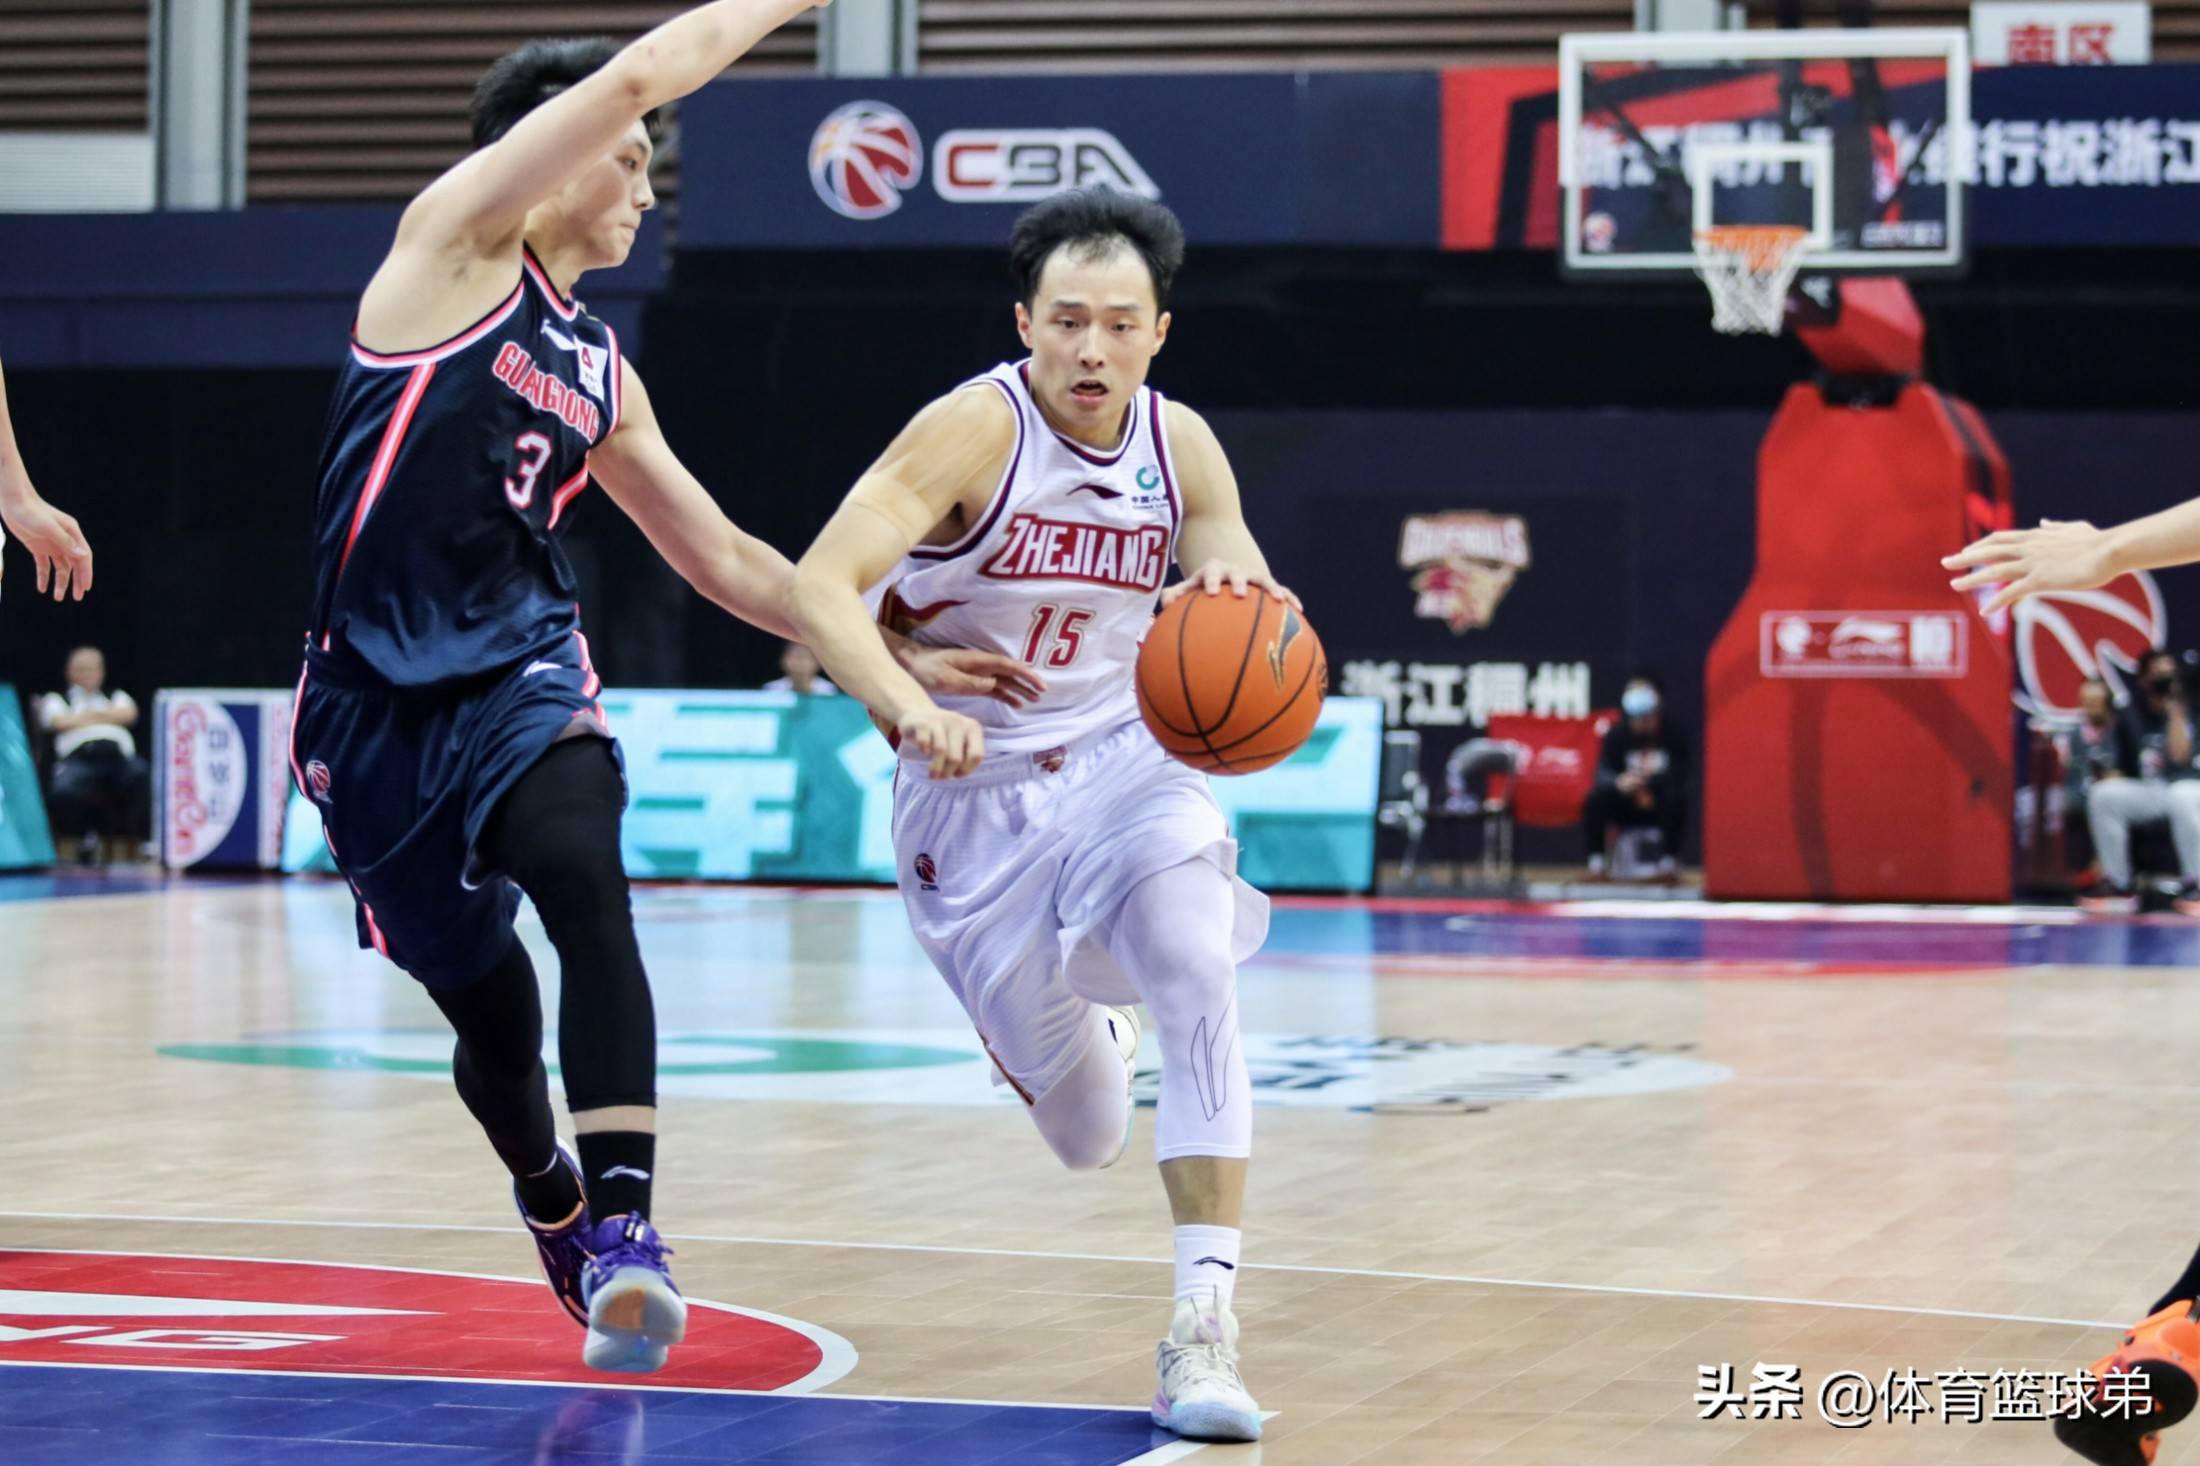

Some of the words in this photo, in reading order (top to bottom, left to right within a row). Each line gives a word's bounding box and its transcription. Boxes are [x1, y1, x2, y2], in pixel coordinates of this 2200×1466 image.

[940, 136, 1148, 196] CBA
[505, 430, 551, 508] 3
[982, 515, 1166, 591] ZHEJIANG
[1023, 603, 1095, 668] 15
